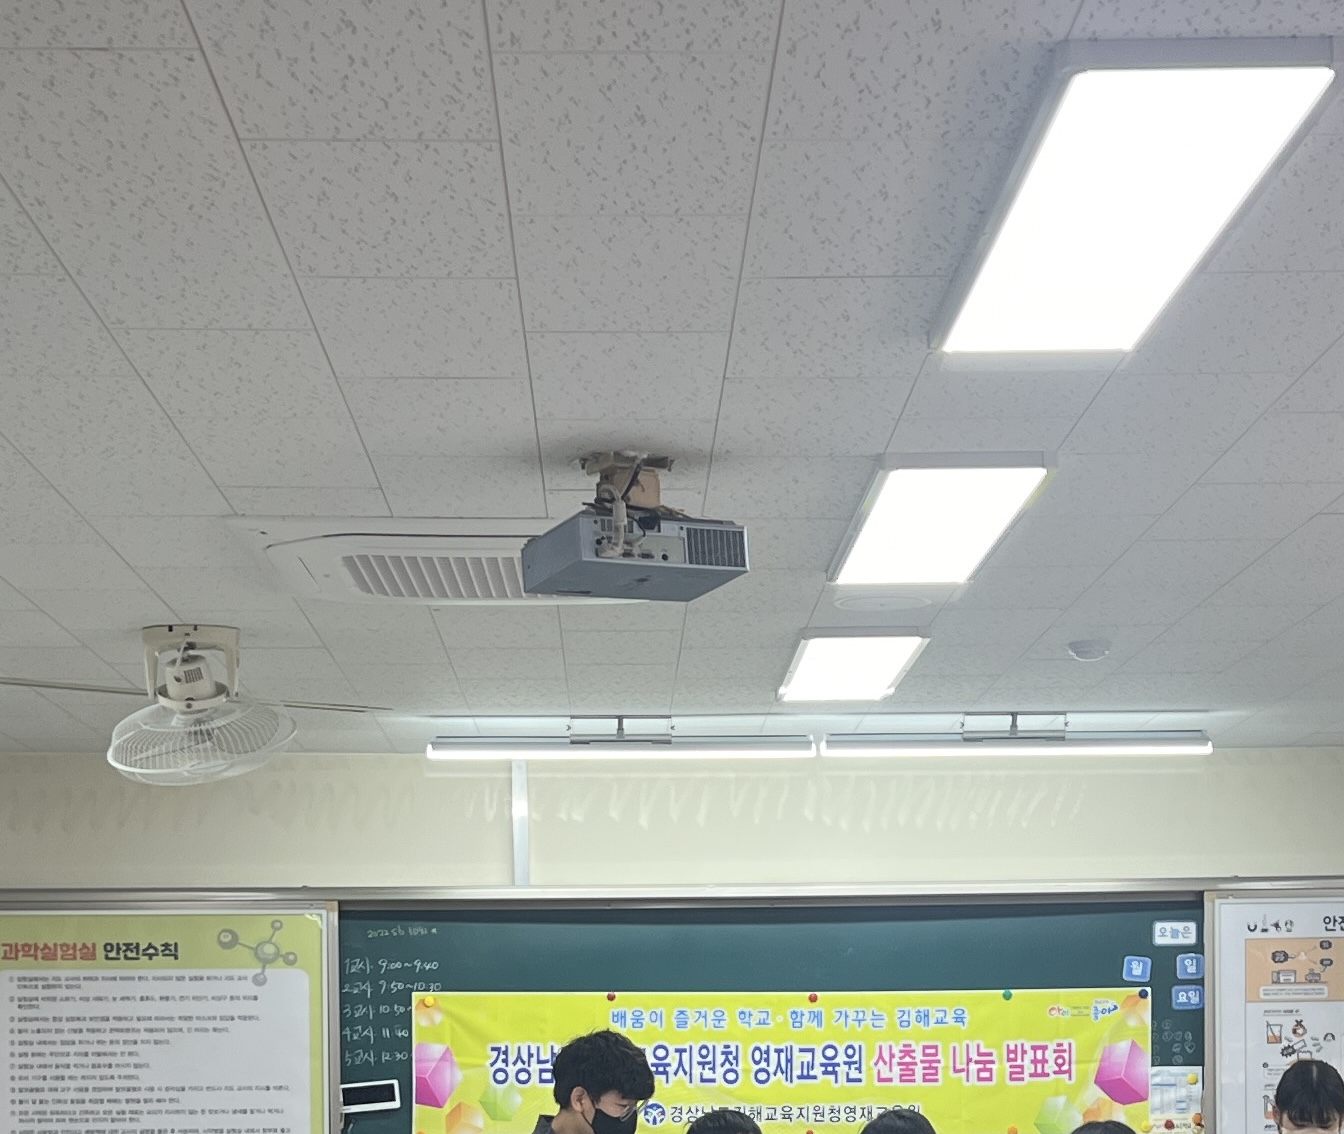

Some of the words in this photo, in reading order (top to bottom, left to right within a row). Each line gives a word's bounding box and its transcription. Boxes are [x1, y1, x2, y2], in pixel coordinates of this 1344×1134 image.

[1157, 925, 1193, 939] 오늘은
[0, 942, 97, 961] 과학실험실
[103, 941, 179, 961] 안전수칙
[1184, 958, 1197, 974] 일
[1177, 990, 1200, 1004] 요일
[611, 1009, 663, 1030] 배움이
[674, 1009, 727, 1030] 즐거운
[738, 1009, 771, 1027] 학교
[790, 1009, 824, 1030] 함께
[834, 1008, 886, 1029] 가꾸는
[897, 1008, 968, 1028] 김해교육
[751, 1043, 863, 1085] 영재교육원
[873, 1043, 942, 1084] 산출물
[952, 1042, 995, 1082] 나눔
[1006, 1041, 1074, 1082] 발표회
